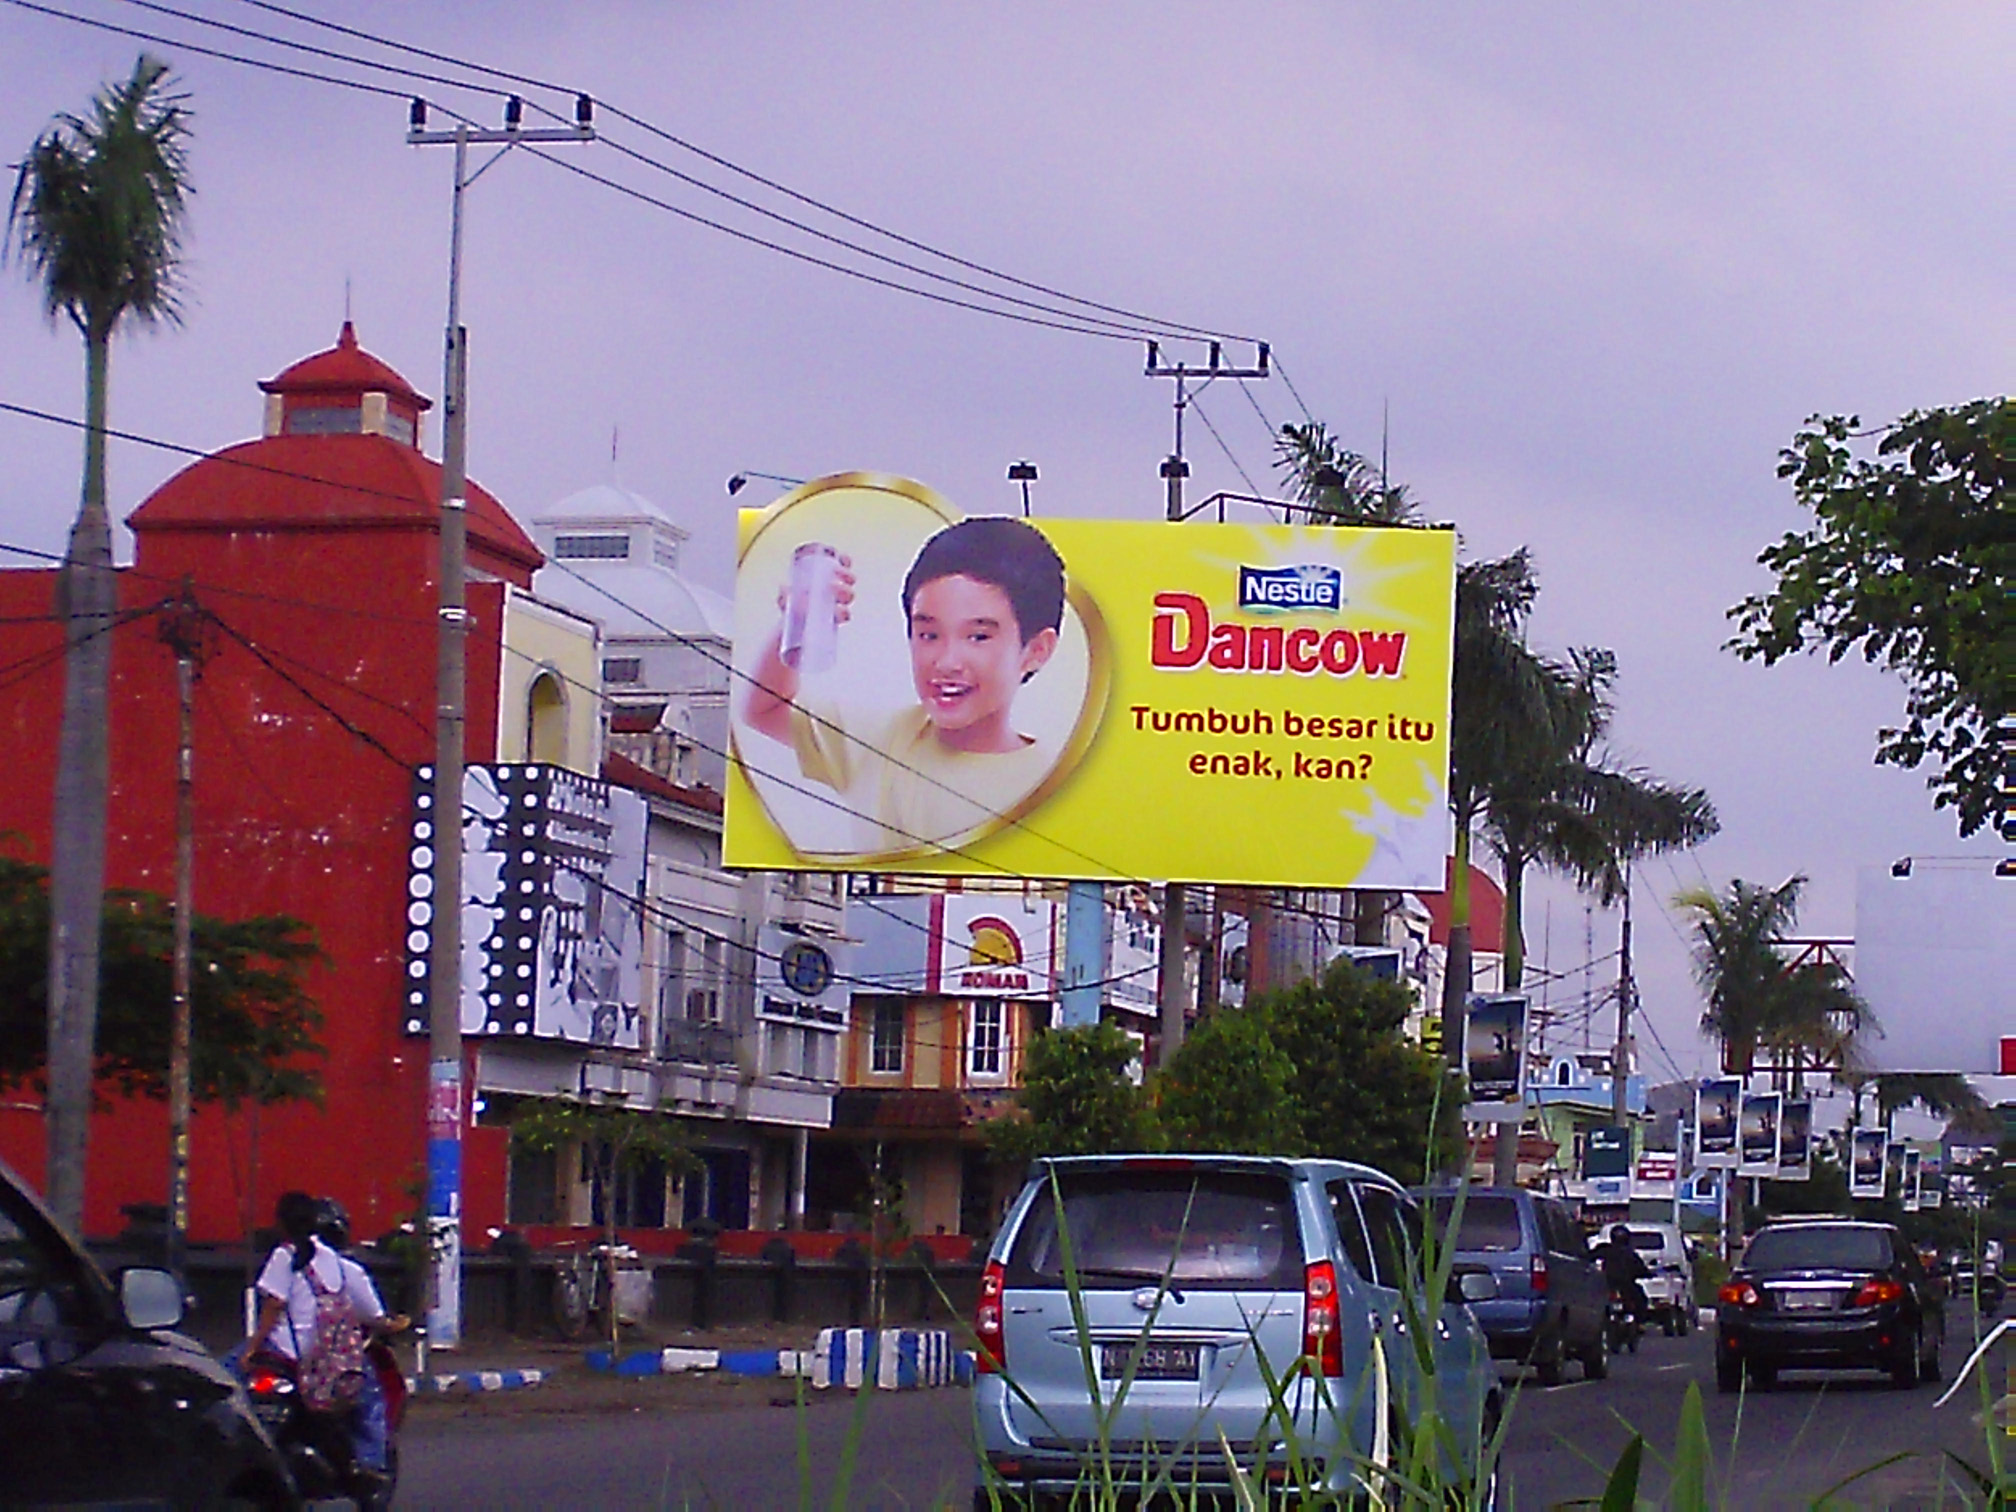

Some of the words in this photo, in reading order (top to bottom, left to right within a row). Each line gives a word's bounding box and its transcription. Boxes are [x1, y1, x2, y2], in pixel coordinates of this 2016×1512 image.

[1130, 706, 1274, 735] Tumbuh
[1283, 710, 1378, 739] besar
[1387, 713, 1435, 742] itu
[1189, 750, 1283, 780] enak,
[1294, 752, 1373, 780] kan?
